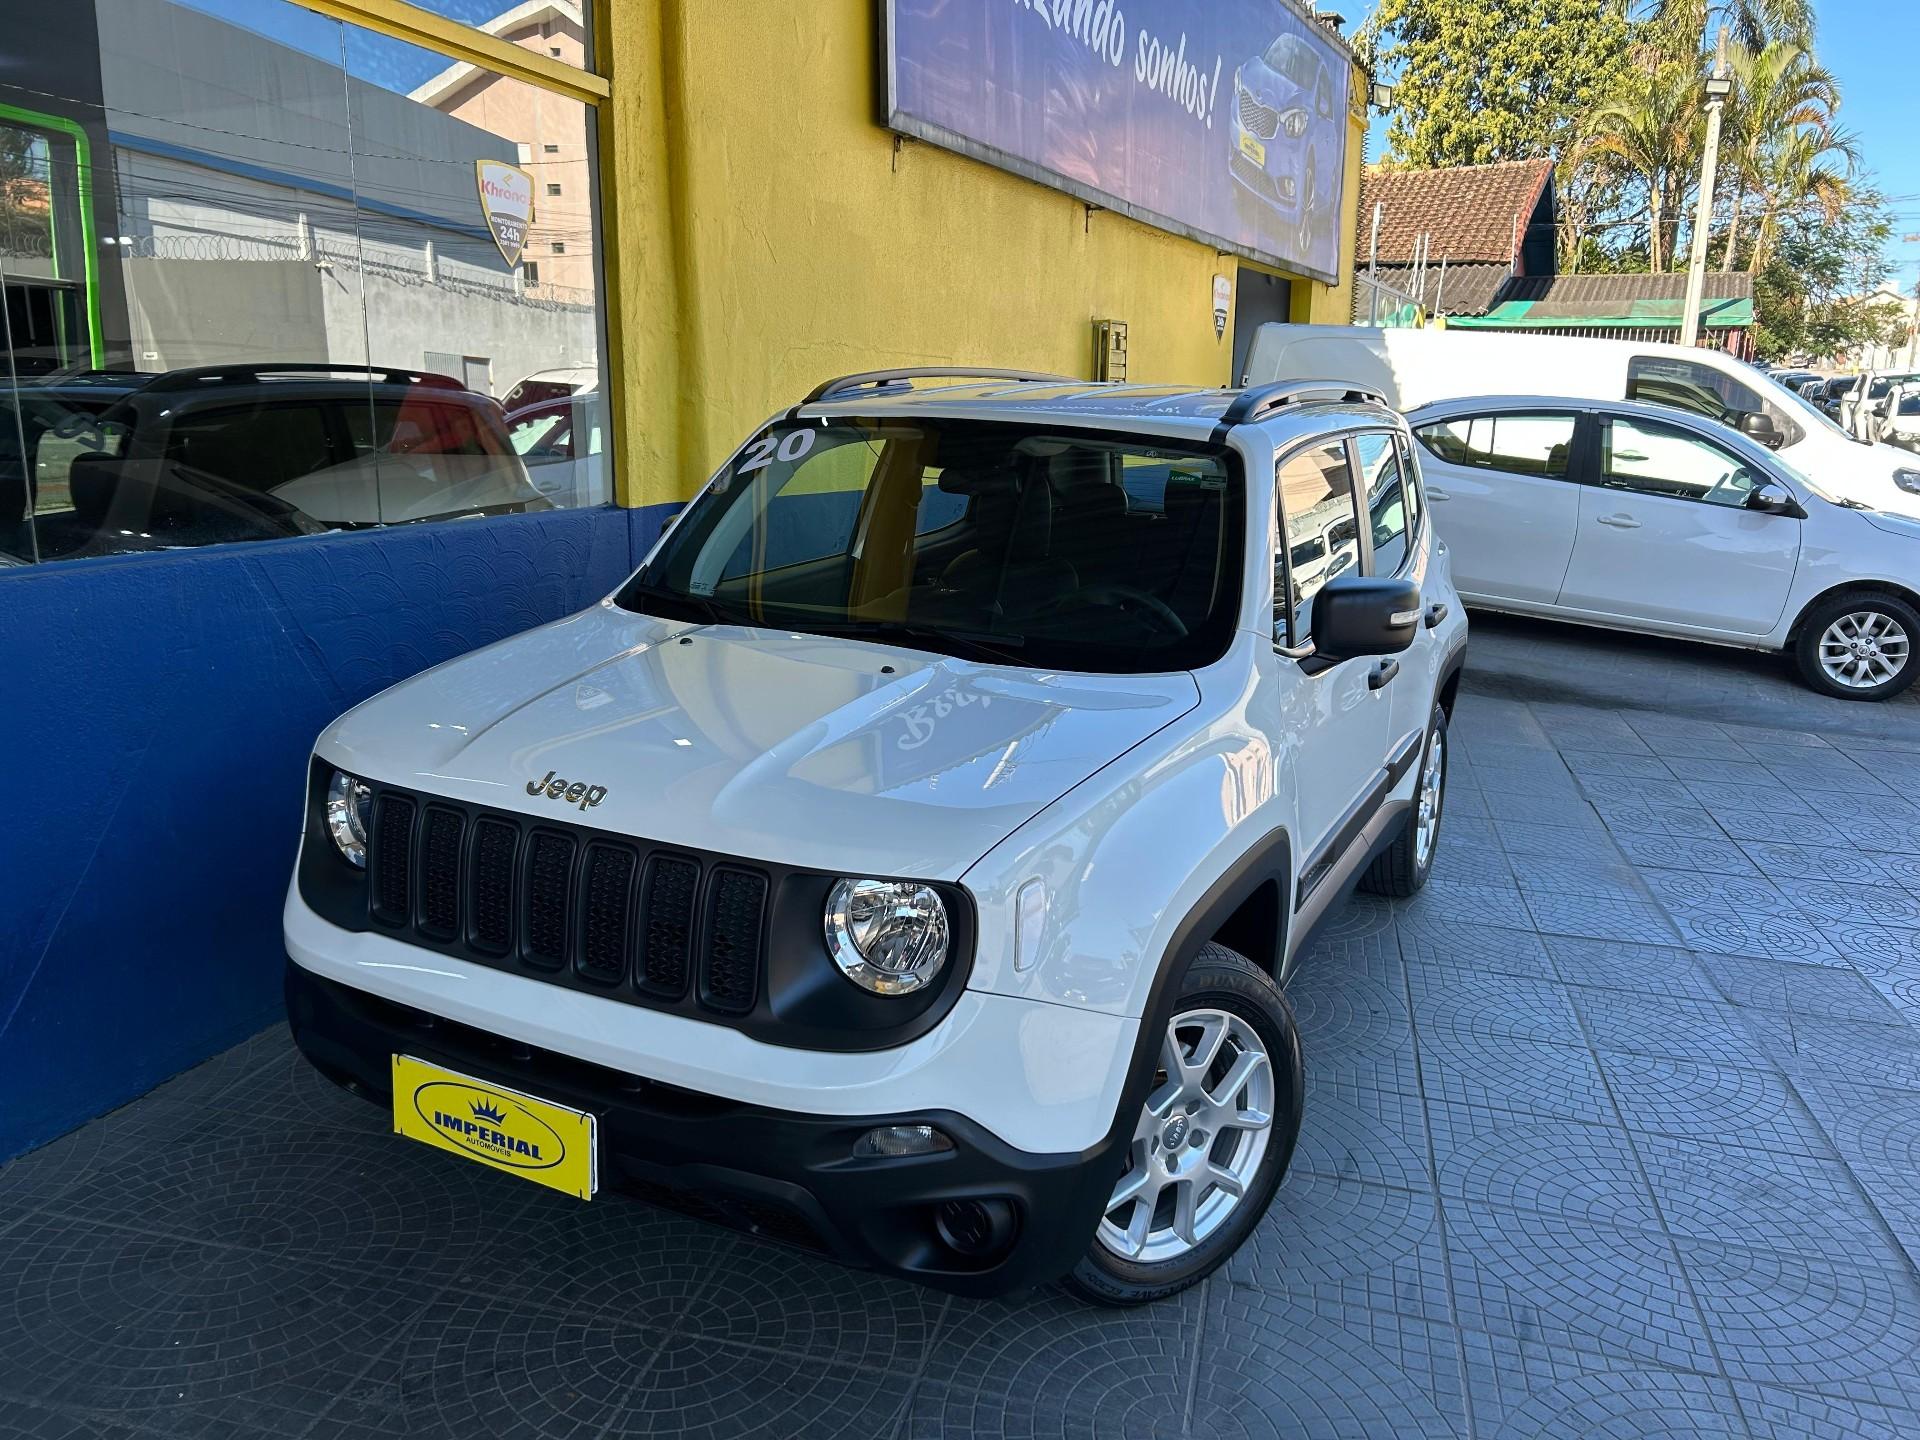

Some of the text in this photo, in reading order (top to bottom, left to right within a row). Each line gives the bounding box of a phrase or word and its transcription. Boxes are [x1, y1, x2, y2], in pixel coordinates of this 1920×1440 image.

[1135, 29, 1221, 129] sonhos!
[500, 225, 520, 242] 24h
[736, 428, 816, 475] 20
[526, 770, 608, 812] Jeep
[434, 1110, 543, 1160] IMPERIAL
[465, 1136, 512, 1157] AUTOMÓVEIS
